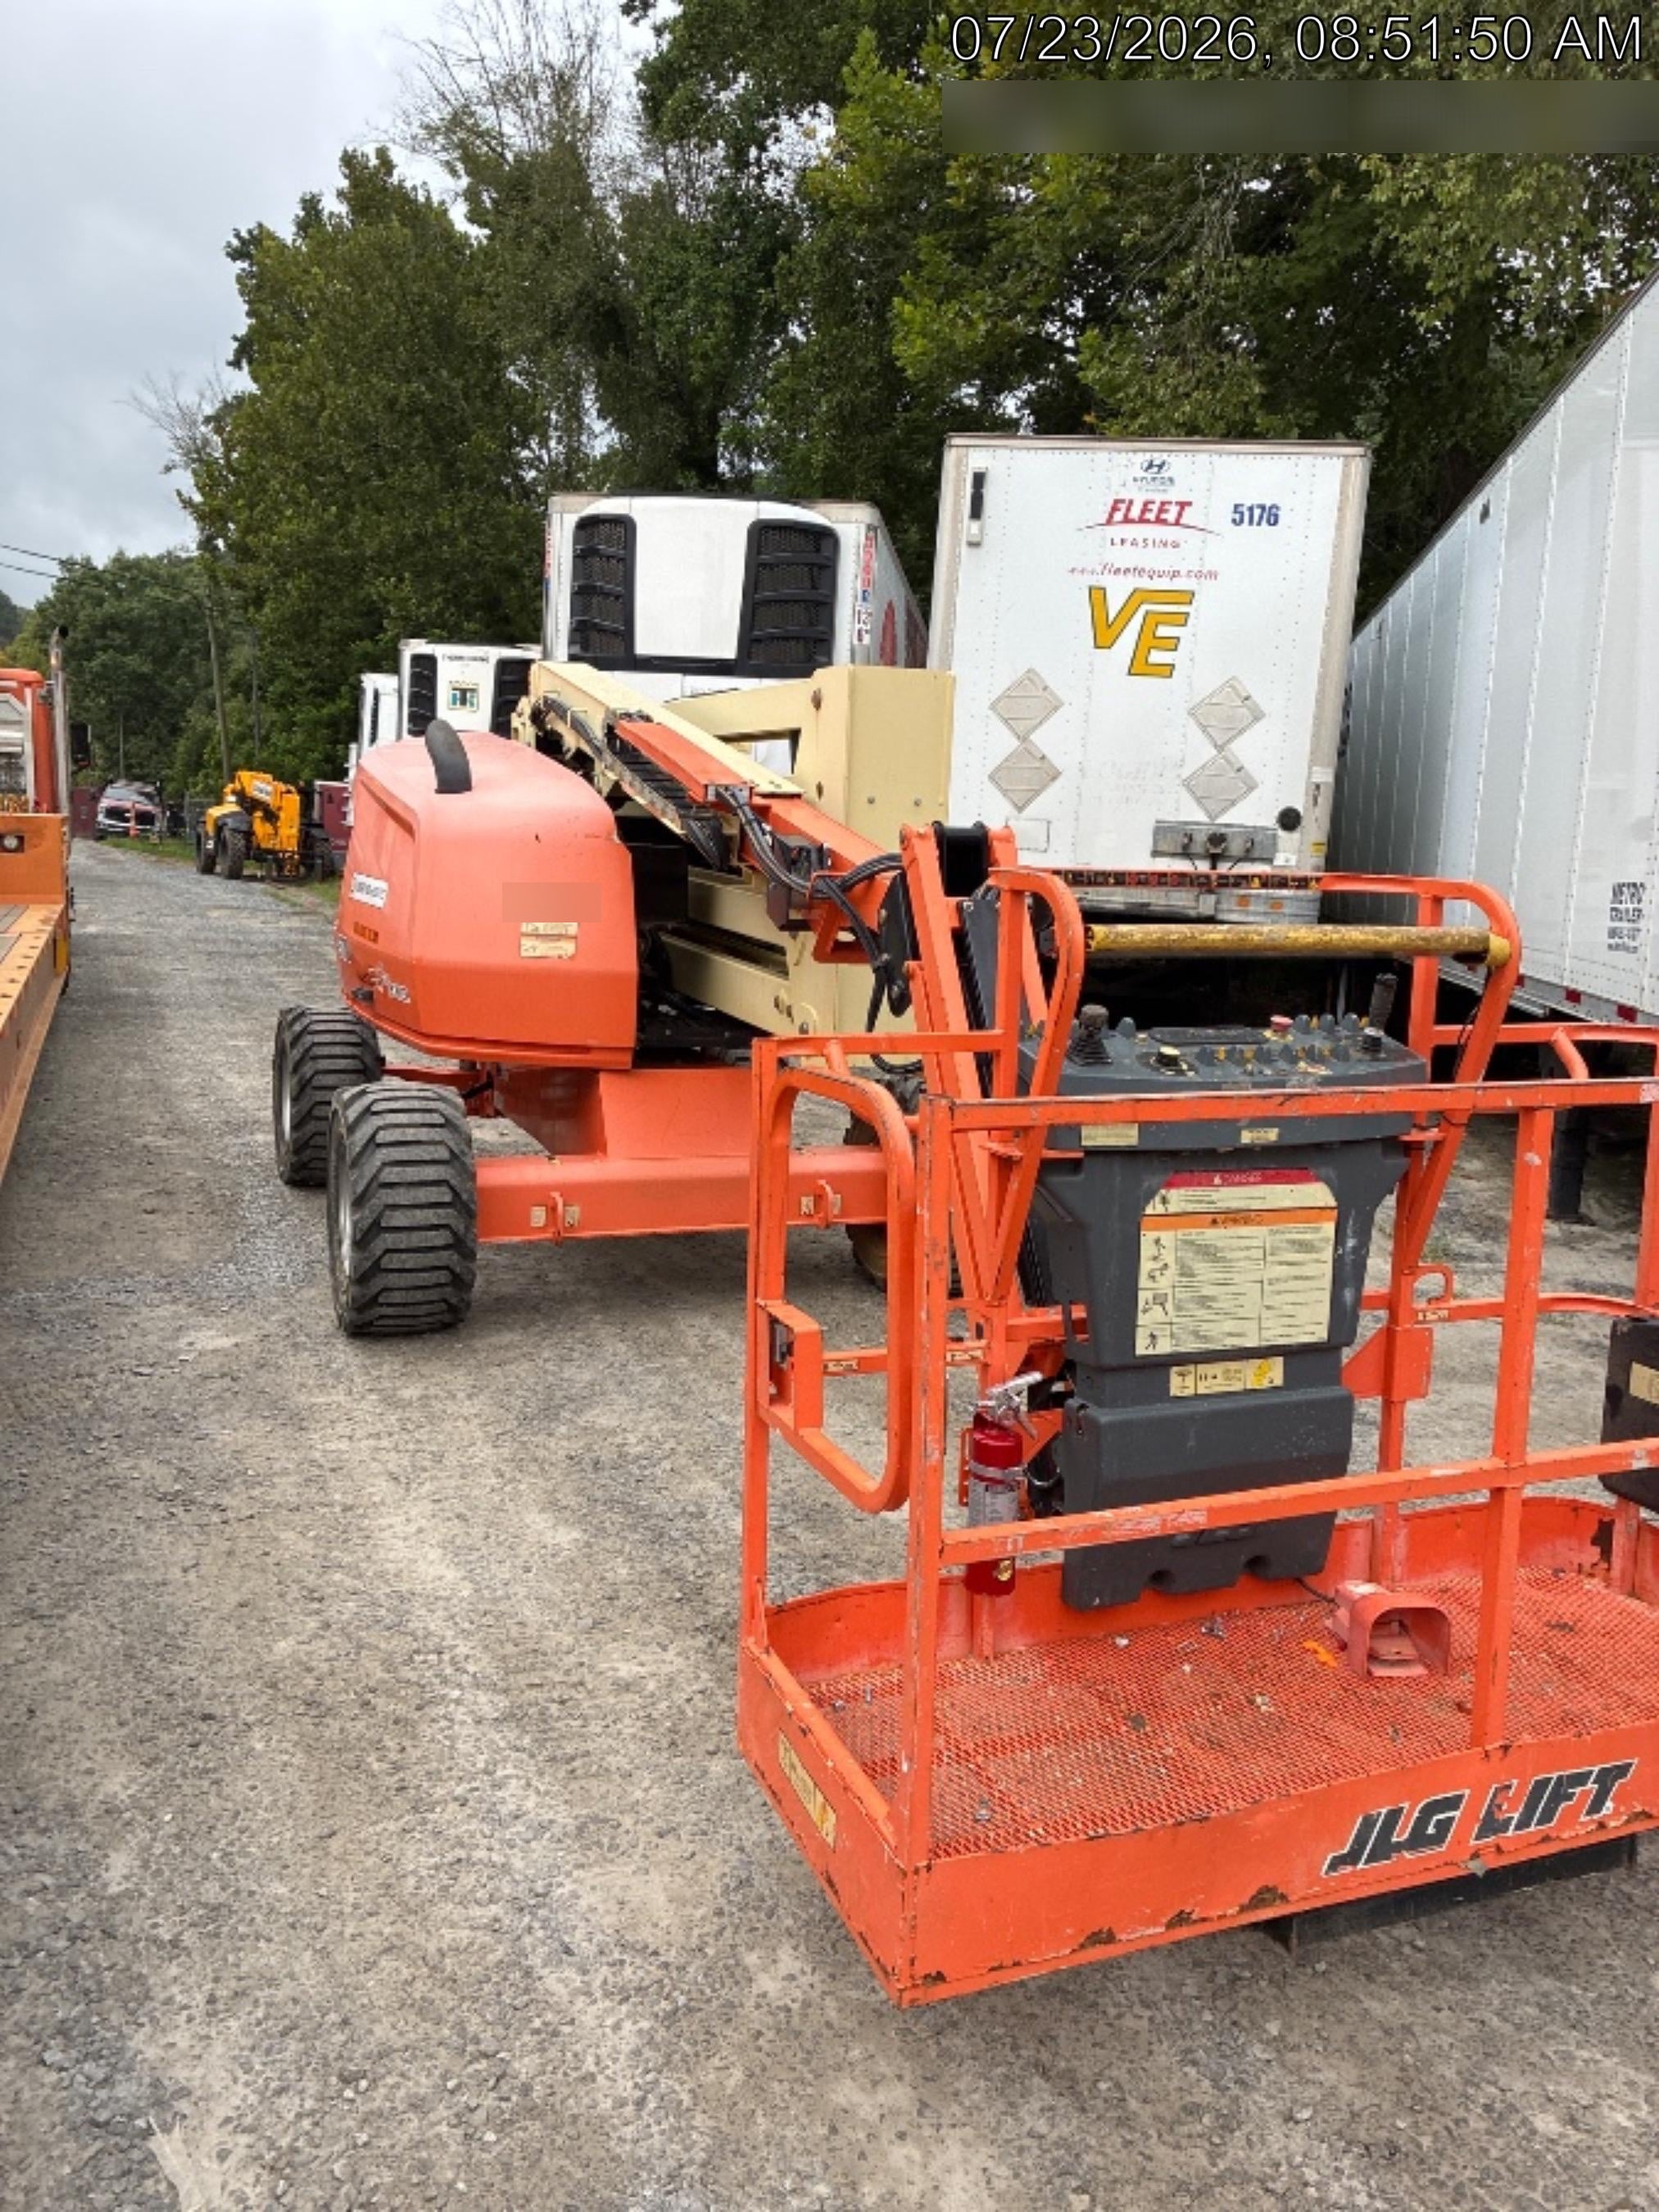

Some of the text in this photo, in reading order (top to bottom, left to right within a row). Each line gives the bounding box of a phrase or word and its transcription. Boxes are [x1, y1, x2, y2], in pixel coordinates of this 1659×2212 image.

[1106, 497, 1193, 526] FLEET
[1231, 502, 1281, 527] 5176
[1109, 537, 1181, 549] LEASING
[1088, 585, 1195, 678] VE
[1321, 1757, 1639, 1879] JLG LIFT
